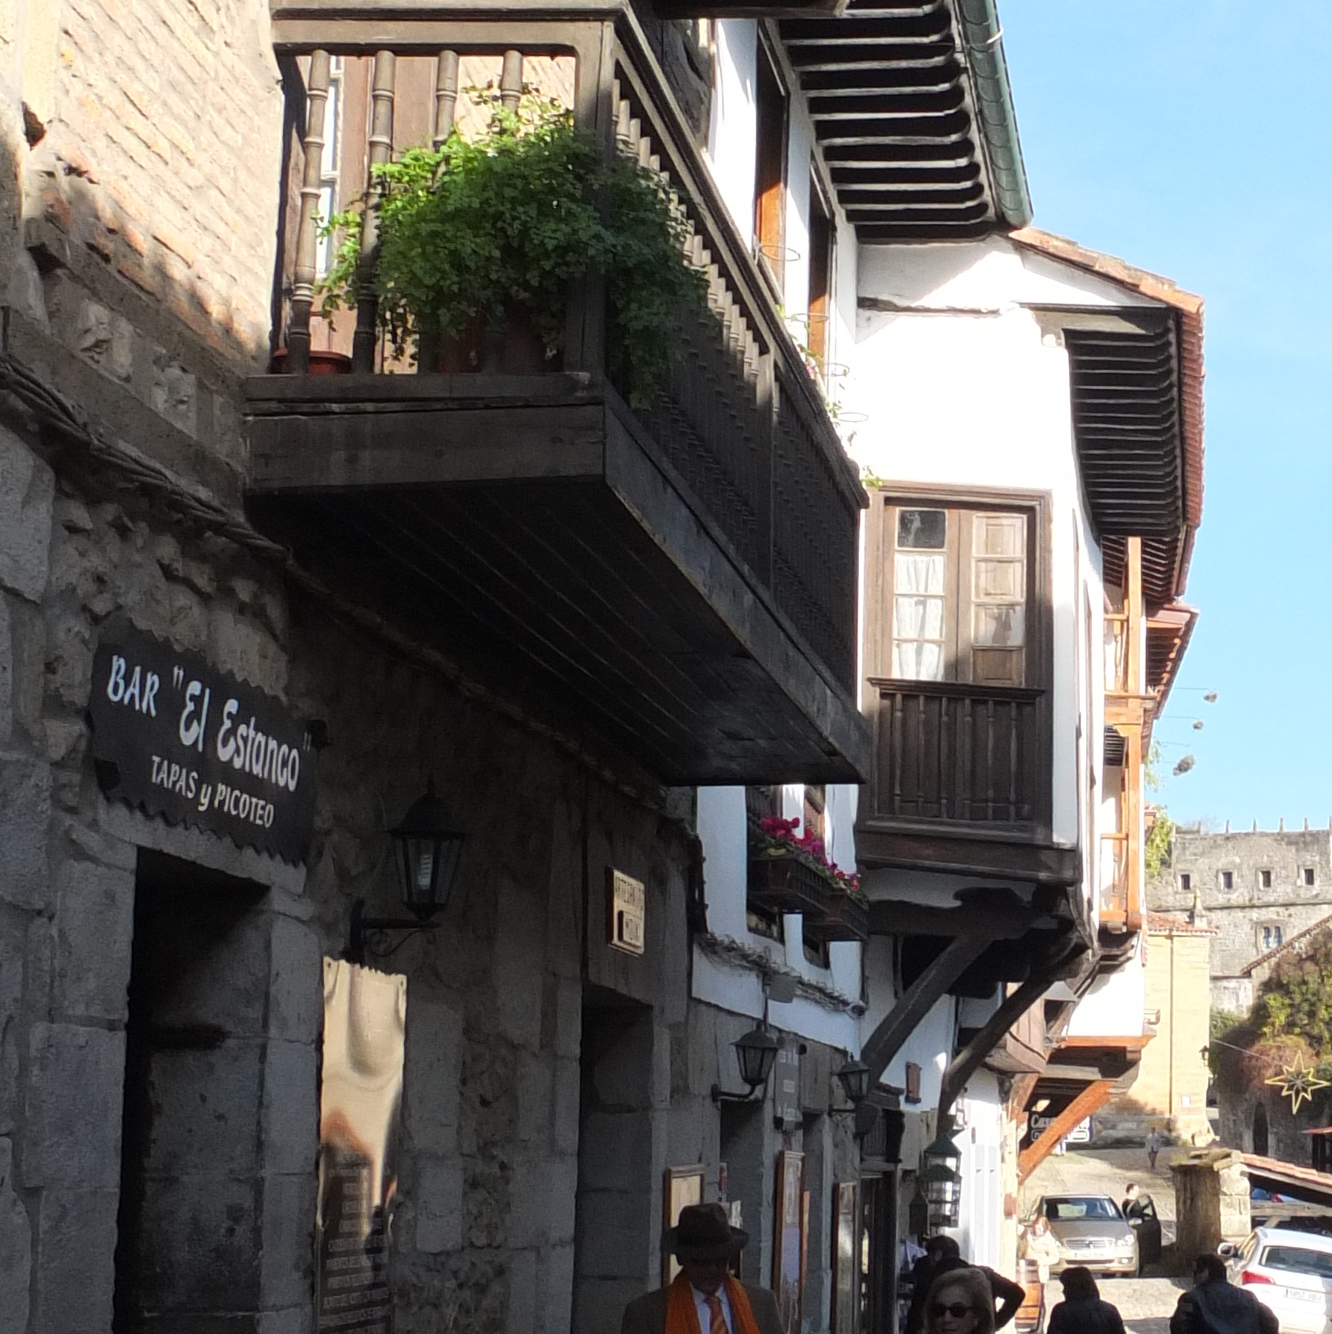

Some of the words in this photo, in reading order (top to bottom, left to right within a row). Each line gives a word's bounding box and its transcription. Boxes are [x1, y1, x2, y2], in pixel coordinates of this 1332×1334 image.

[107, 655, 159, 717] BAR
[151, 755, 199, 799] TAPAS
[198, 784, 212, 812] y
[213, 782, 276, 829] PICOTEO
